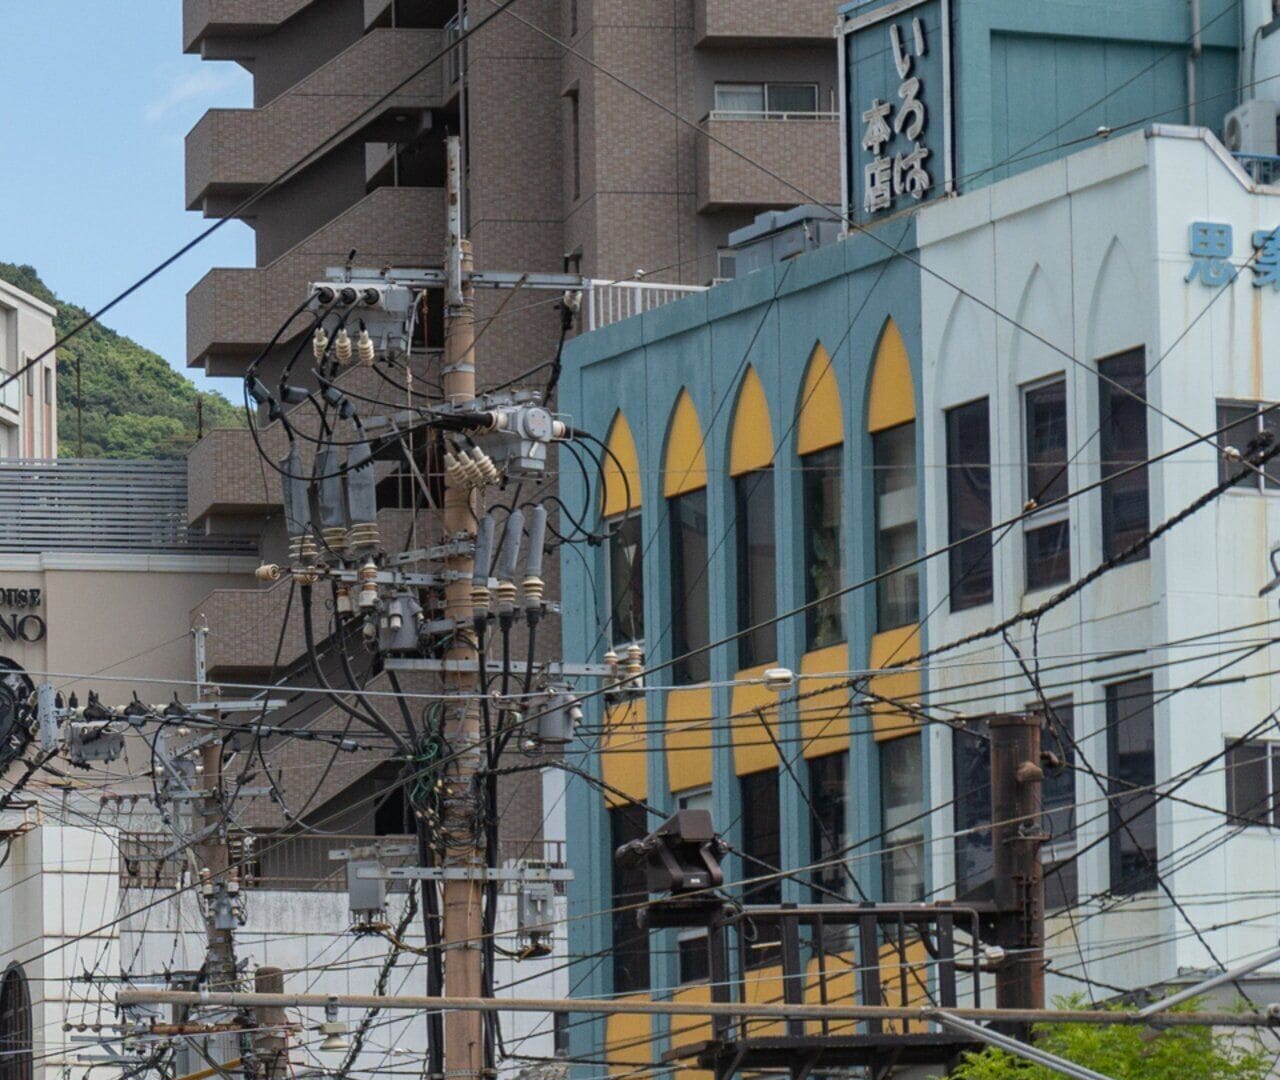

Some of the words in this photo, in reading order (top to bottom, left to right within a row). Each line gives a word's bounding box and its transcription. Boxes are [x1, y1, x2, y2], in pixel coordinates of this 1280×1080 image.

[862, 97, 894, 214] 本店
[890, 16, 932, 198] いろは
